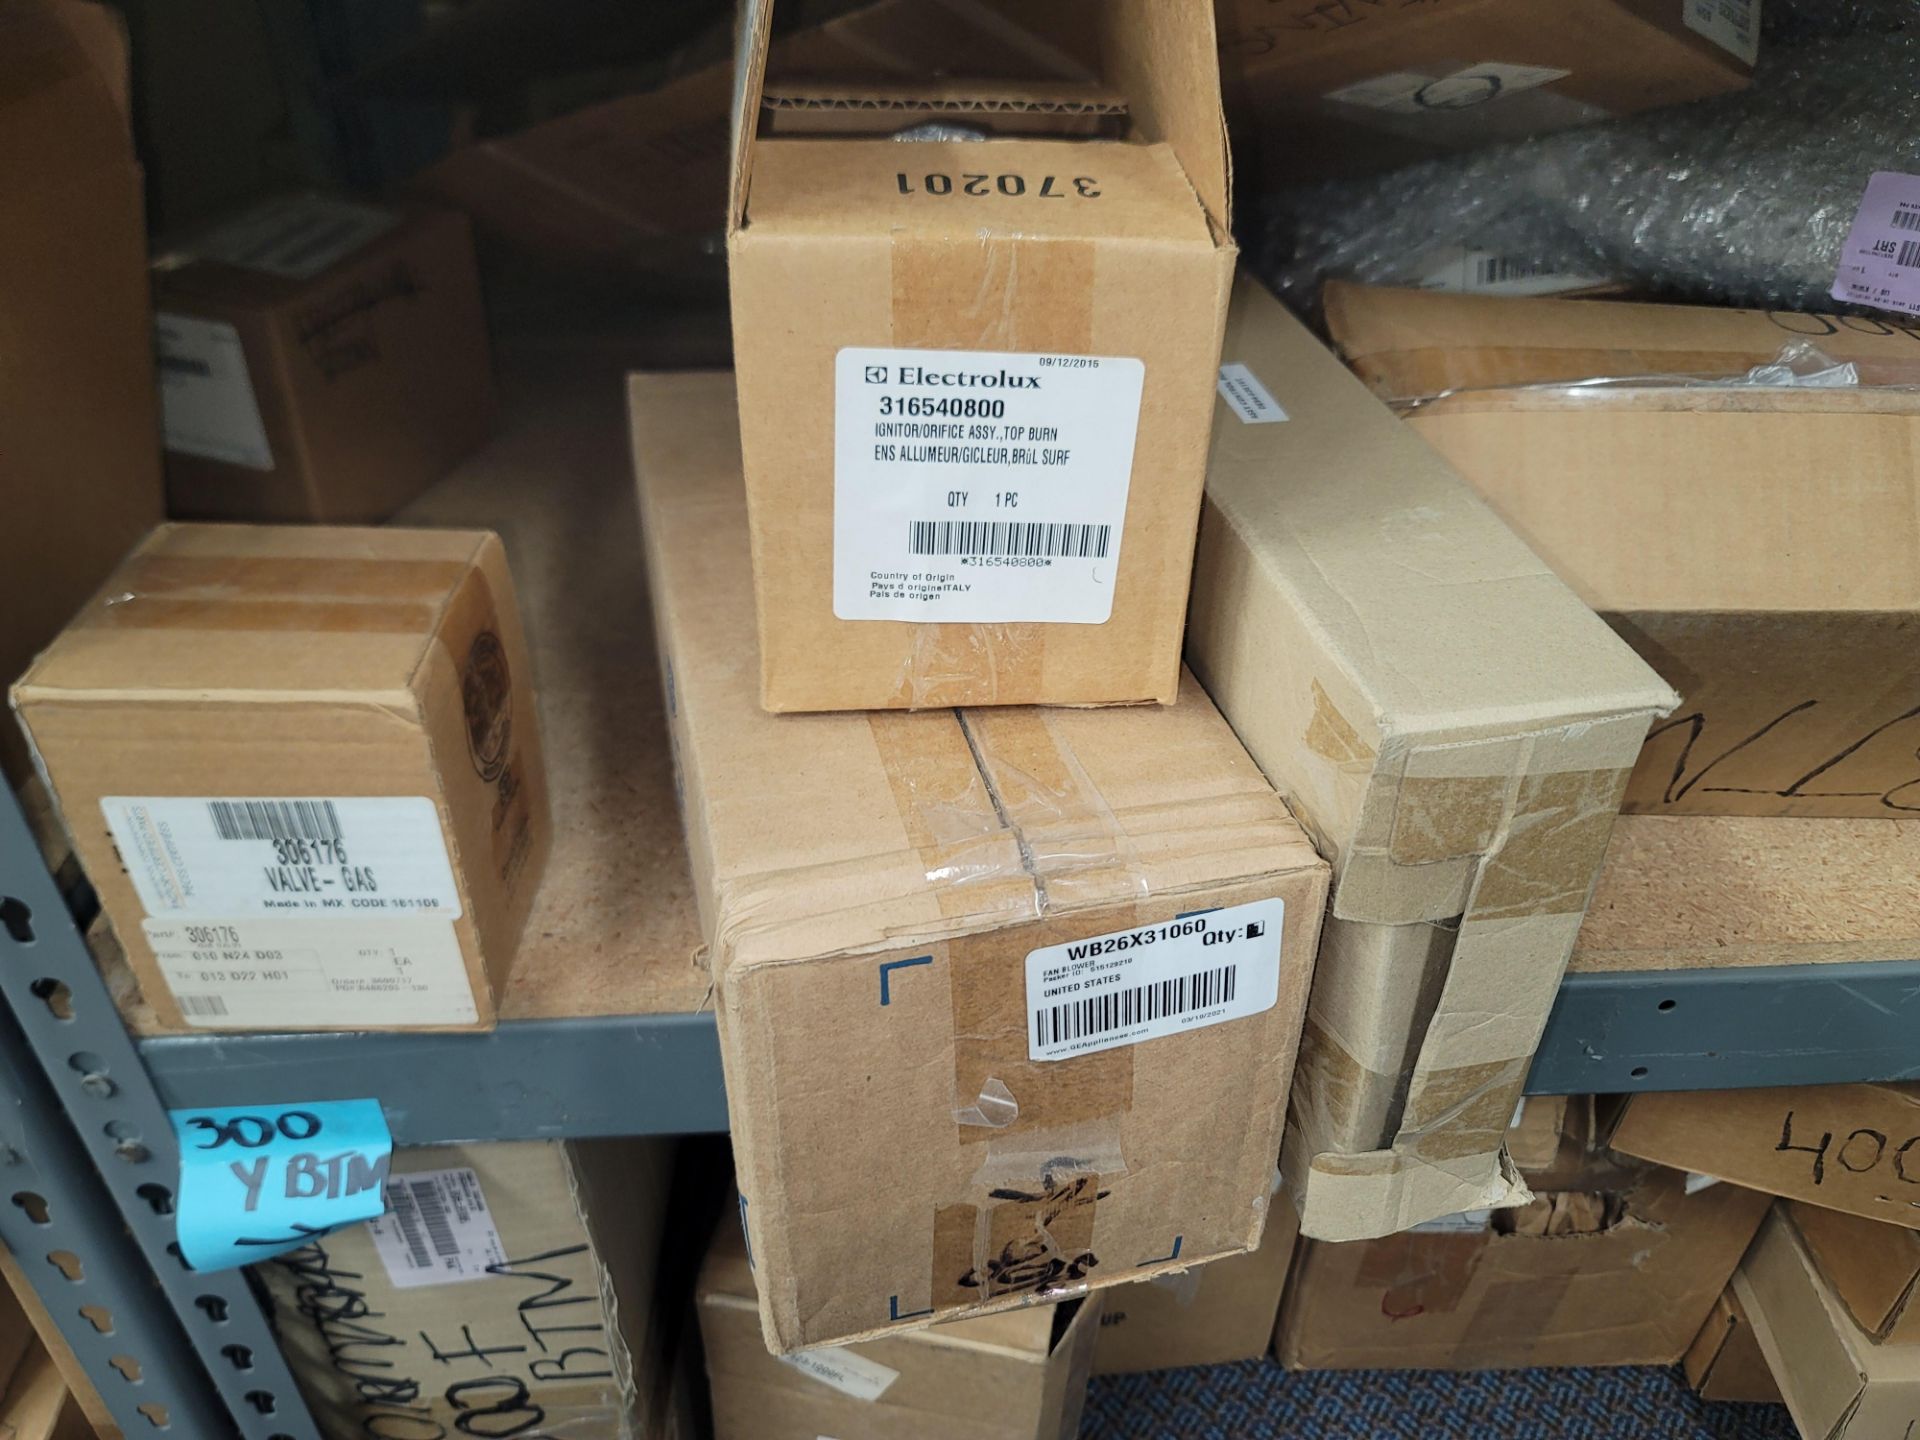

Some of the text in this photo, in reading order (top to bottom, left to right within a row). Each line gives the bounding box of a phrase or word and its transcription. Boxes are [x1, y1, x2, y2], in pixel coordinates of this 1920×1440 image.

[897, 173, 1101, 198] 370201
[1872, 240, 1897, 253] SRT
[899, 367, 1042, 389] Electrolux
[880, 396, 1005, 418] 316540800
[875, 423, 964, 439] IGNITOR/ORIFICE
[1028, 427, 1058, 442] BURN
[875, 445, 896, 462] ENS
[1042, 450, 1071, 466] SURF
[947, 491, 1018, 508] QTY 1 PC
[870, 571, 955, 583] Country of Origin
[872, 582, 895, 591] Pays
[893, 591, 905, 599] de
[909, 592, 941, 601] origen
[272, 838, 348, 866] 306176
[343, 867, 378, 892] GAS
[263, 899, 301, 908] Made
[323, 899, 346, 908] MX
[351, 898, 388, 908] CODE
[185, 926, 240, 943] 306176
[1068, 918, 1206, 961] WB26X31060
[1202, 926, 1243, 947] Qty:
[1043, 960, 1095, 977] FAN BLOWER
[1044, 974, 1121, 998] UNITED STATES
[186, 1110, 323, 1149] 300
[230, 1150, 391, 1212] Y BTM
